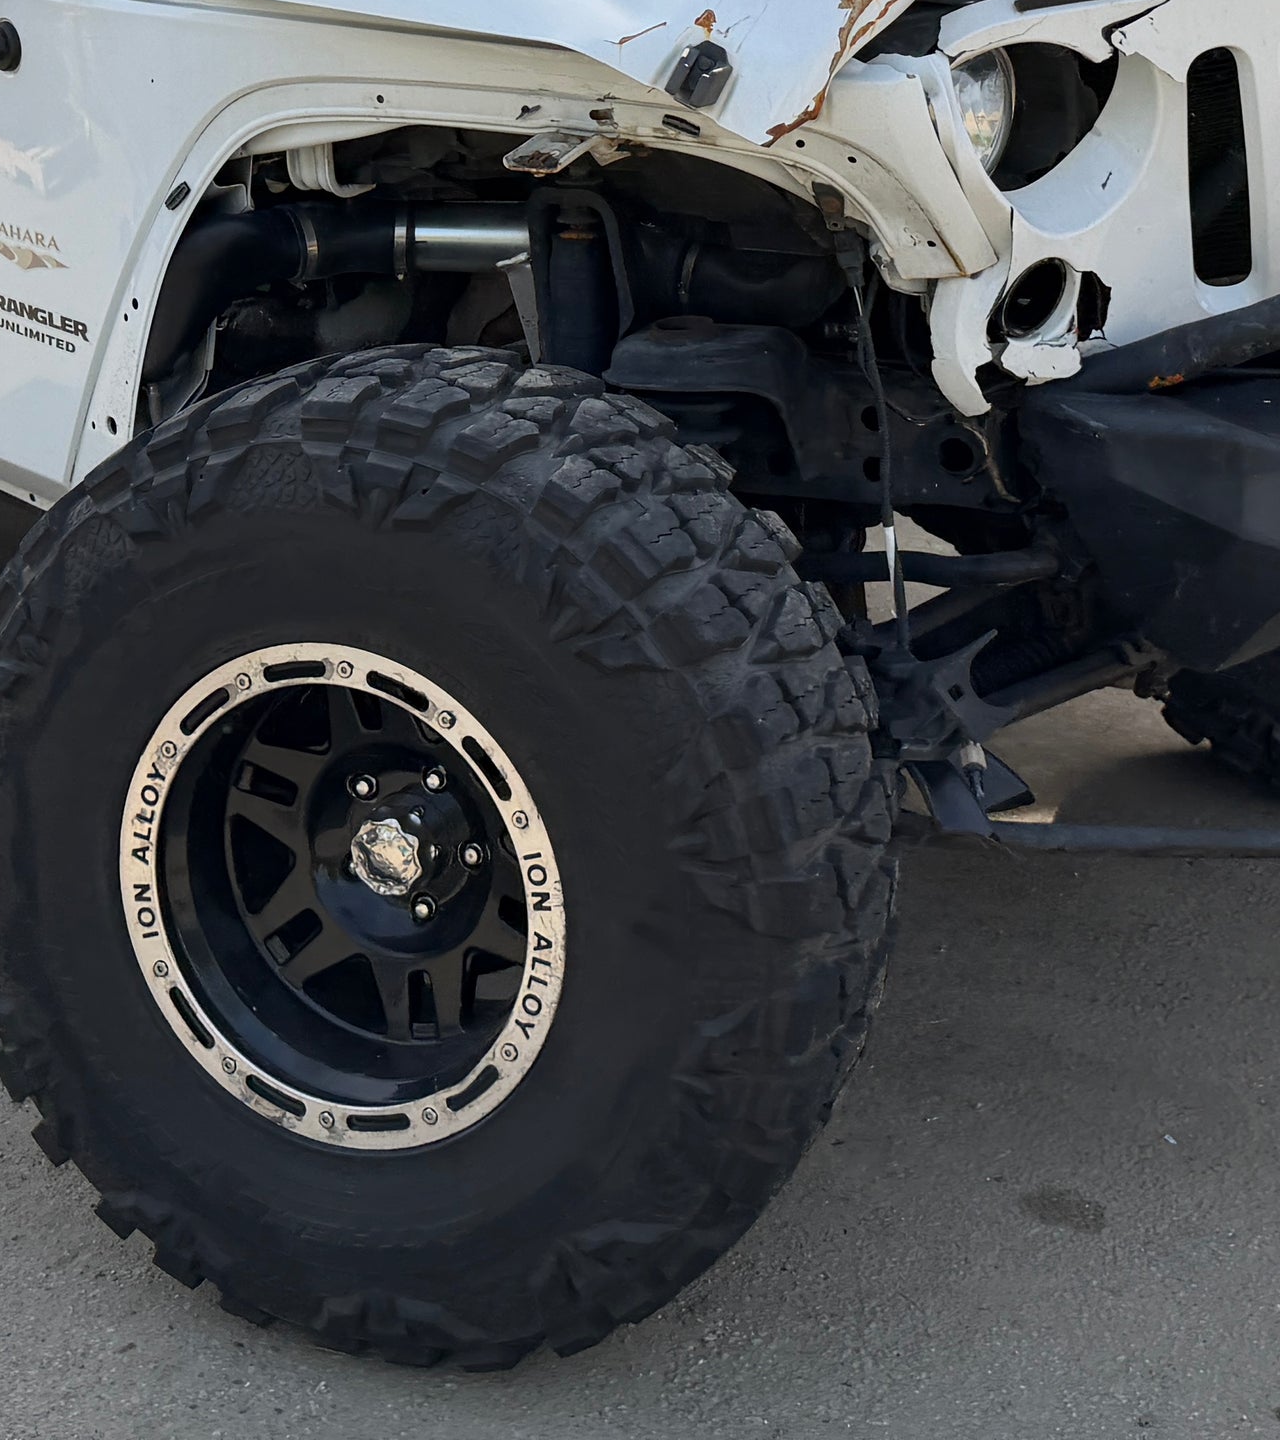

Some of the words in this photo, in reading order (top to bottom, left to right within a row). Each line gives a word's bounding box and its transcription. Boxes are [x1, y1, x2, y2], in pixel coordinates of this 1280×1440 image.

[131, 762, 168, 867] ALLOY
[134, 881, 159, 940] ION
[522, 851, 552, 913] ION
[514, 930, 554, 1041] ALLOY
